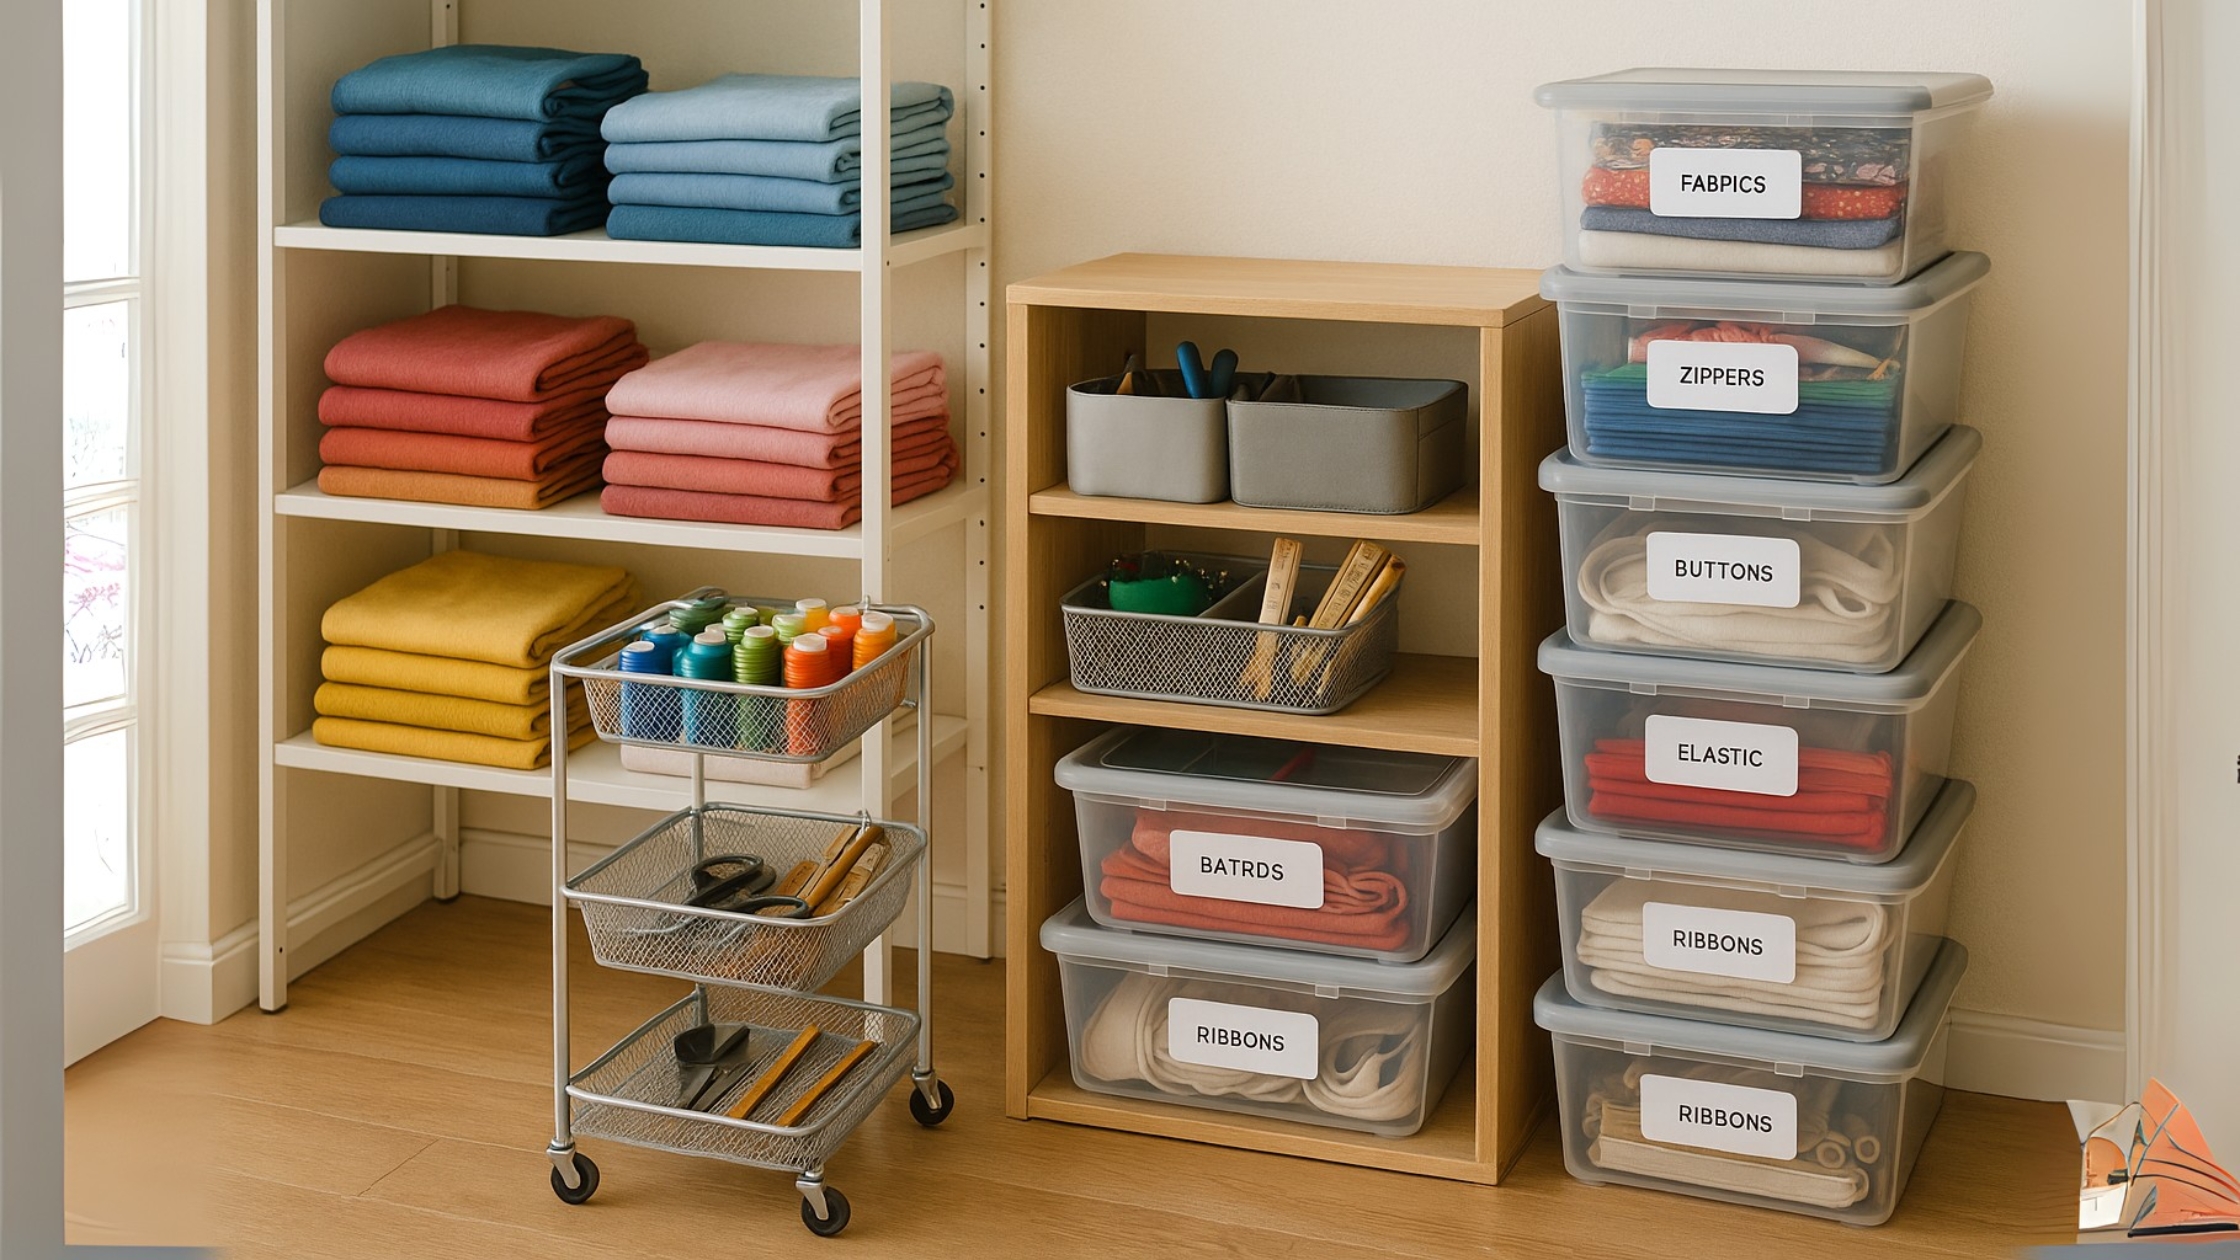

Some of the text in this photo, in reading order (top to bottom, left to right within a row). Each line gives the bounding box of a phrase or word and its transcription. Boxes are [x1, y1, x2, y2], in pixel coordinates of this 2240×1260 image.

[1681, 173, 1767, 194] FABPICS
[1679, 366, 1765, 386] ZIPPERS
[1675, 560, 1773, 583] BUTTONS
[1678, 743, 1763, 767] ELASTIC
[1201, 856, 1285, 880] BATRDS
[1673, 930, 1763, 955] RIBBONS
[1197, 1026, 1285, 1051] RIBBONS
[1679, 1105, 1772, 1132] RIBBONS
